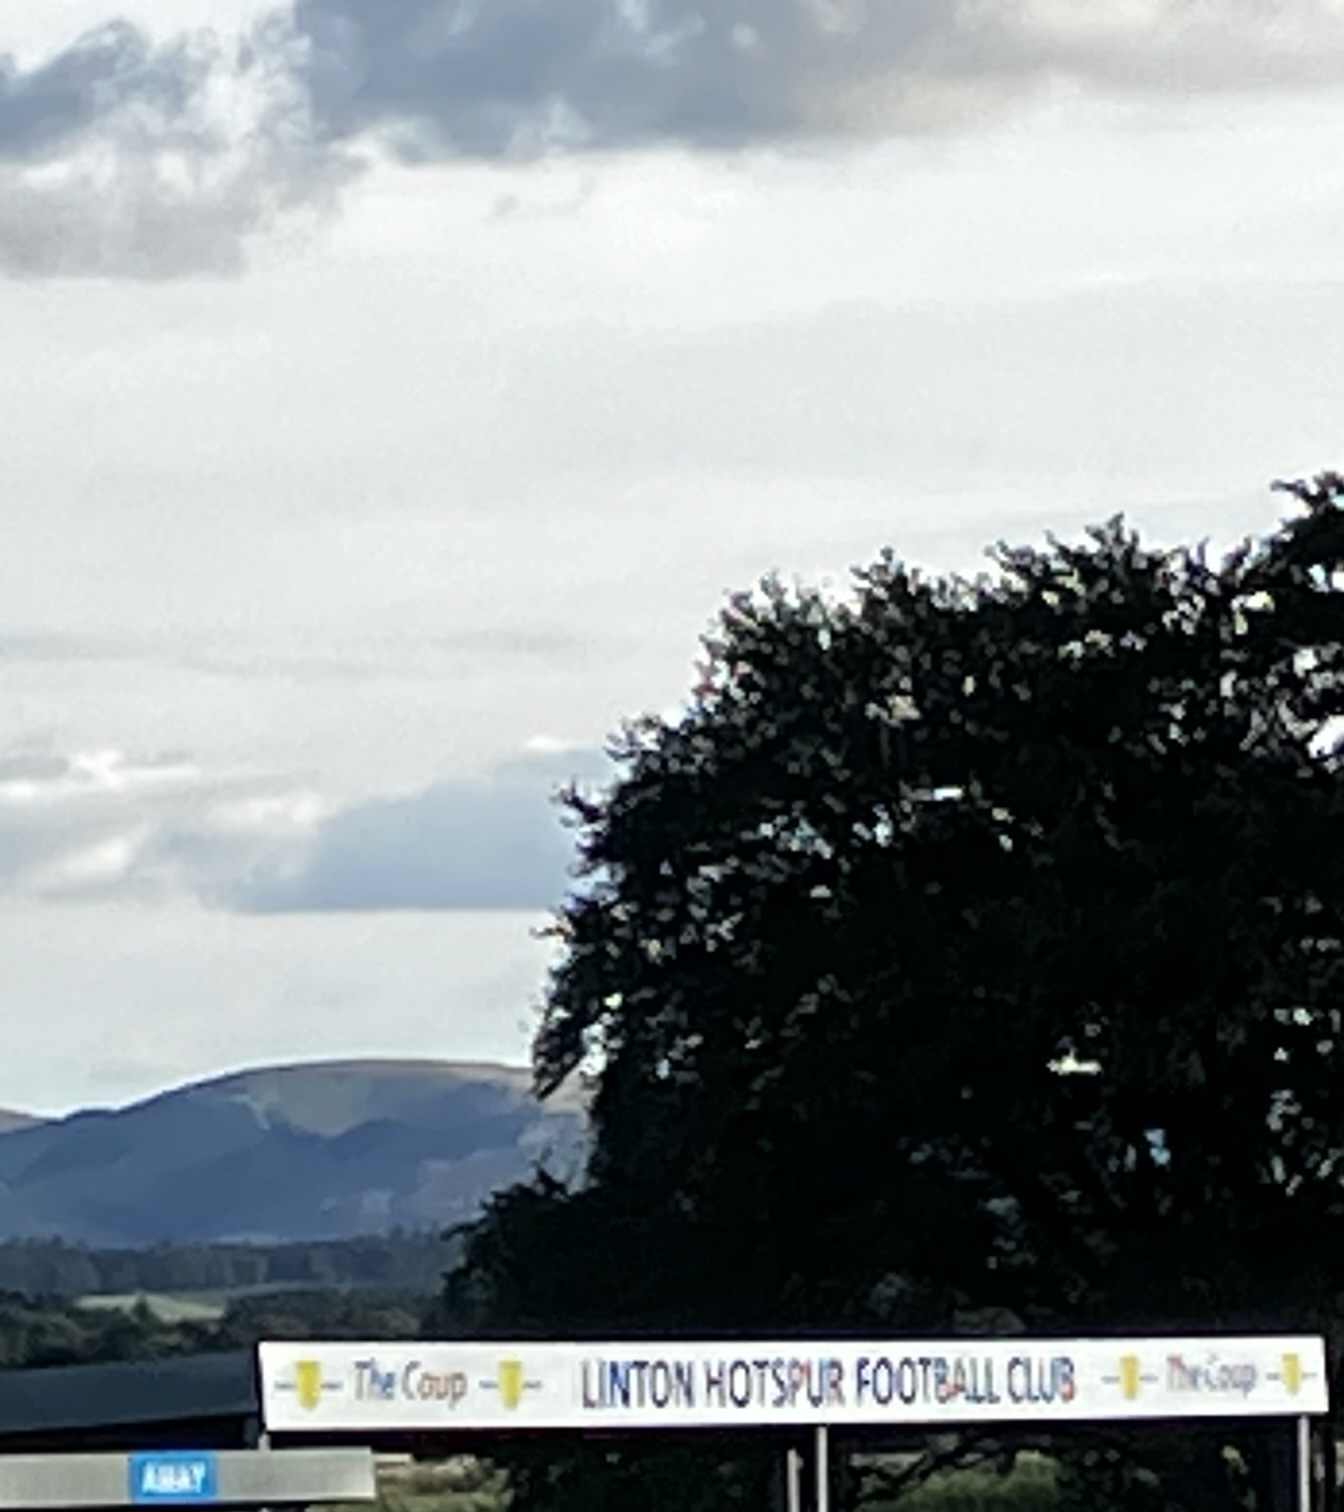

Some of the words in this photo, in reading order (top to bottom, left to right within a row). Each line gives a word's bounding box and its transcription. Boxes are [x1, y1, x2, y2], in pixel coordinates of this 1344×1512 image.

[353, 1357, 395, 1401] The
[401, 1359, 468, 1411] Coup
[581, 1358, 694, 1408] LINTON
[703, 1357, 847, 1408] HOTSPUR
[856, 1356, 1001, 1405] FOOTBALL
[1007, 1356, 1075, 1404] CLUB
